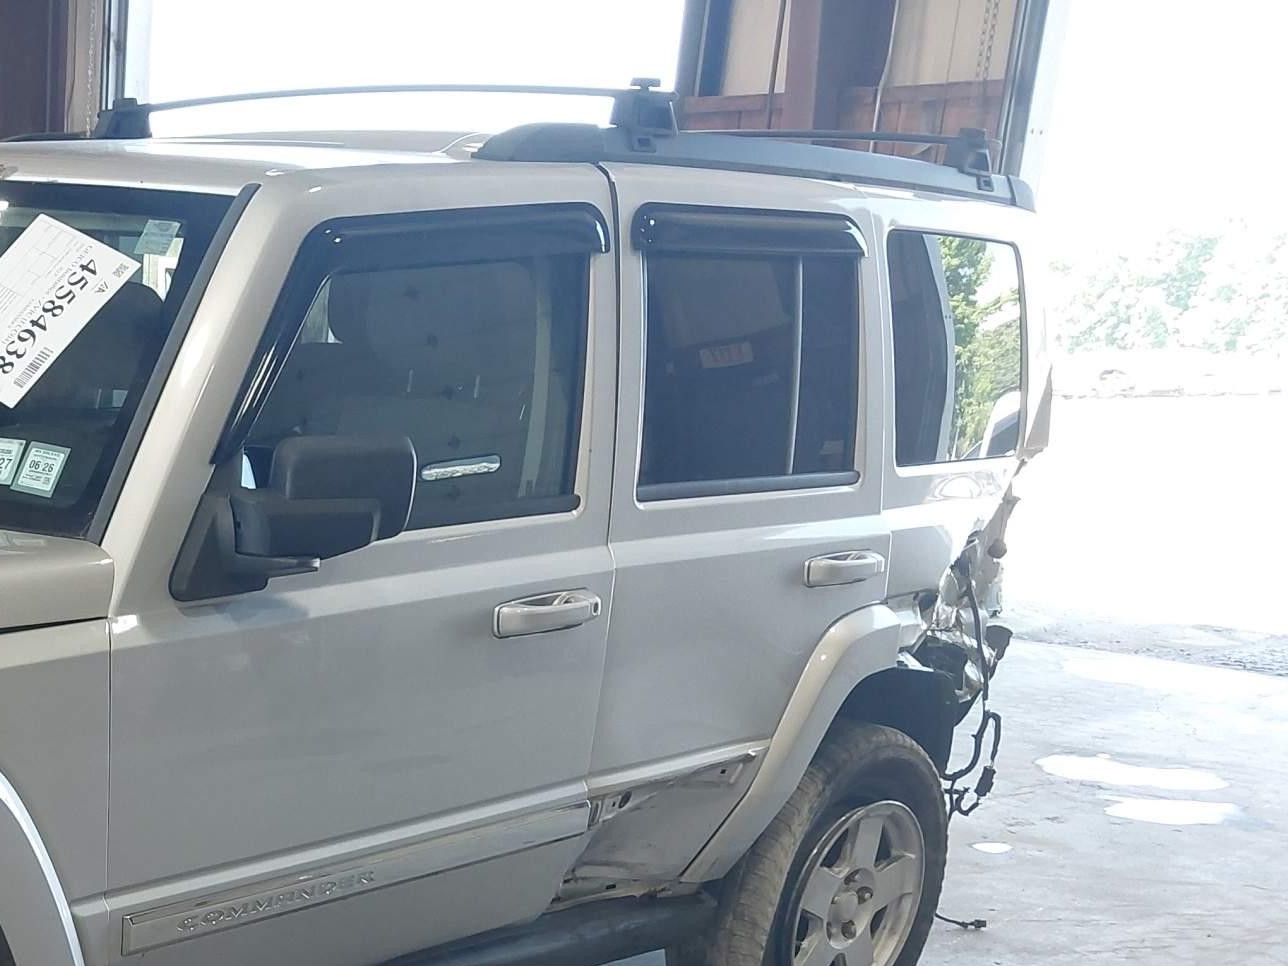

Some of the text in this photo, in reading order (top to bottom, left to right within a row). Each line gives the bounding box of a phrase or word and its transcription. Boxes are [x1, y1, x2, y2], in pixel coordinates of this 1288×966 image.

[29, 459, 55, 473] 06 26
[176, 871, 376, 932] COMMANDER
